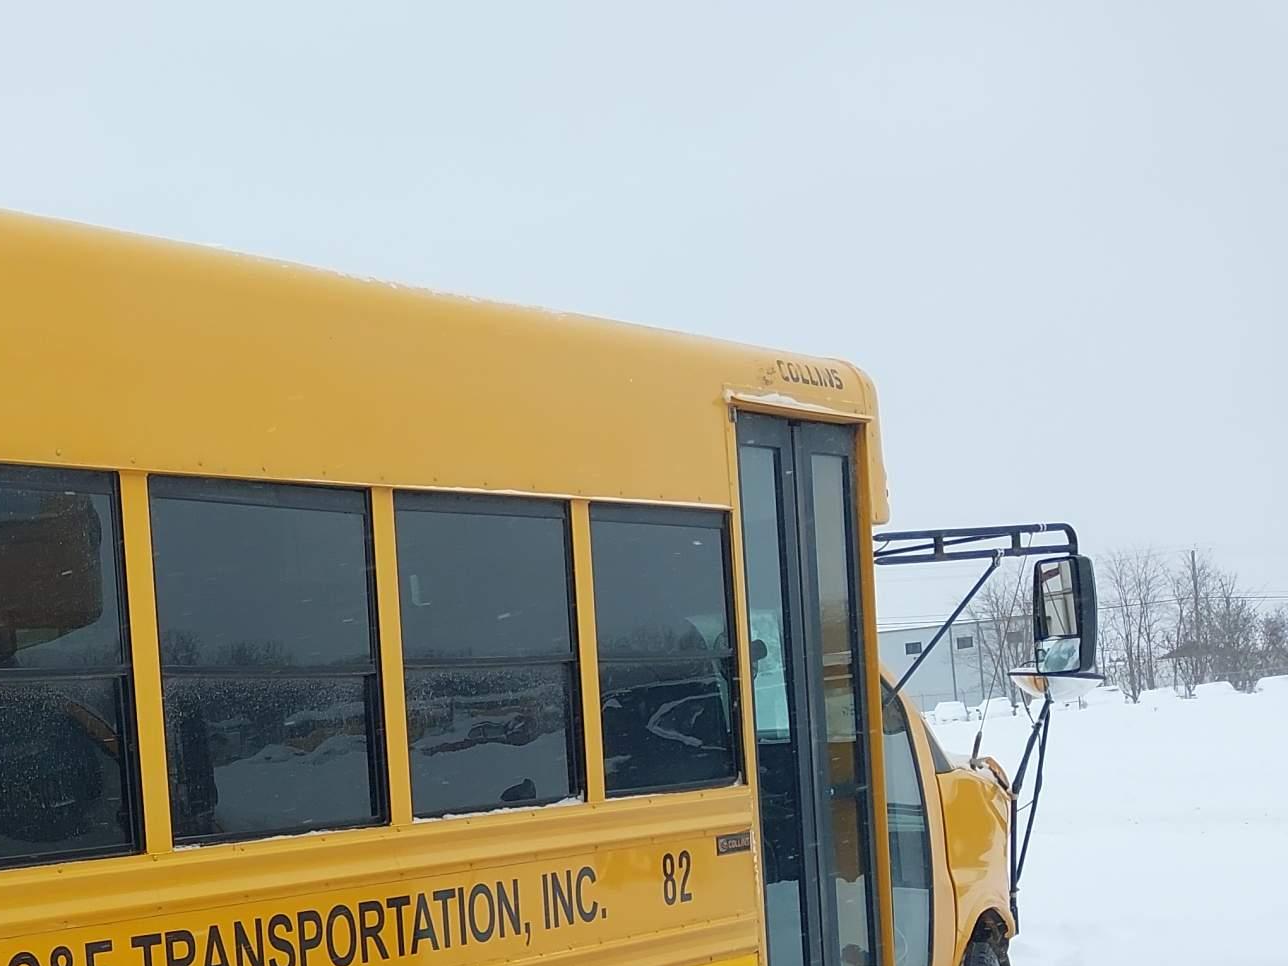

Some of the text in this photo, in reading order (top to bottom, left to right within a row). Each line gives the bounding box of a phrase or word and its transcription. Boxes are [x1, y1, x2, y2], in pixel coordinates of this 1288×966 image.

[776, 359, 843, 390] COLLINS
[541, 866, 607, 929] INC.
[662, 850, 692, 906] 82
